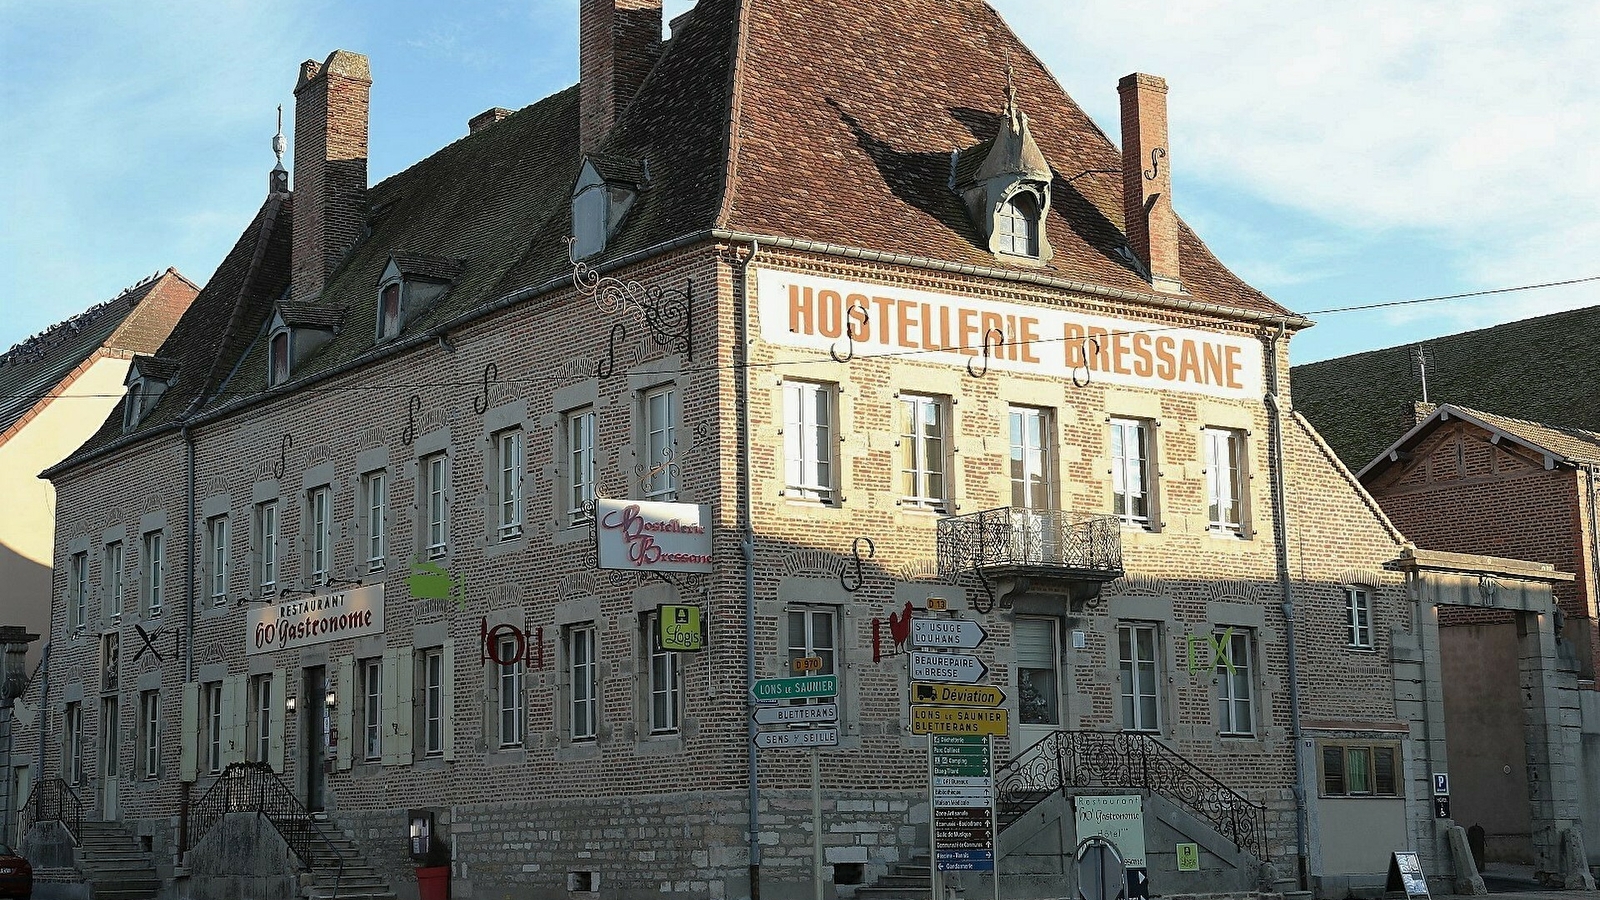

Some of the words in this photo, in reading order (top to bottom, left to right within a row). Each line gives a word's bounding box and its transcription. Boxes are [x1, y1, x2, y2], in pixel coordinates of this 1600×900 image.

[788, 284, 1041, 365] HOSTELLERIE
[1064, 322, 1243, 390] BRESSANE
[602, 504, 705, 543] Hostellerie
[629, 535, 712, 567] Bressane
[281, 594, 345, 618] RESTAURANT
[928, 601, 934, 609] D
[936, 601, 946, 609] 13
[930, 623, 962, 633] USUGE
[665, 624, 700, 647] Logis
[915, 634, 960, 643] LOUHANS
[796, 661, 801, 669] D
[804, 659, 818, 668] 970
[915, 656, 974, 667] BEAUREPAIRE
[925, 668, 958, 677] BRESSE
[760, 683, 783, 695] LONS
[785, 686, 792, 694] LE
[795, 680, 833, 693] SAUNIER
[942, 688, 995, 703] Déviation
[778, 708, 834, 719] BLETTERANS
[915, 711, 940, 720] LONS
[958, 711, 1001, 721] SAUNIER
[915, 721, 978, 731] BLETTERANS
[766, 734, 789, 744] SENS
[803, 732, 835, 742] SEILLE
[1079, 797, 1139, 805] Restaurant
